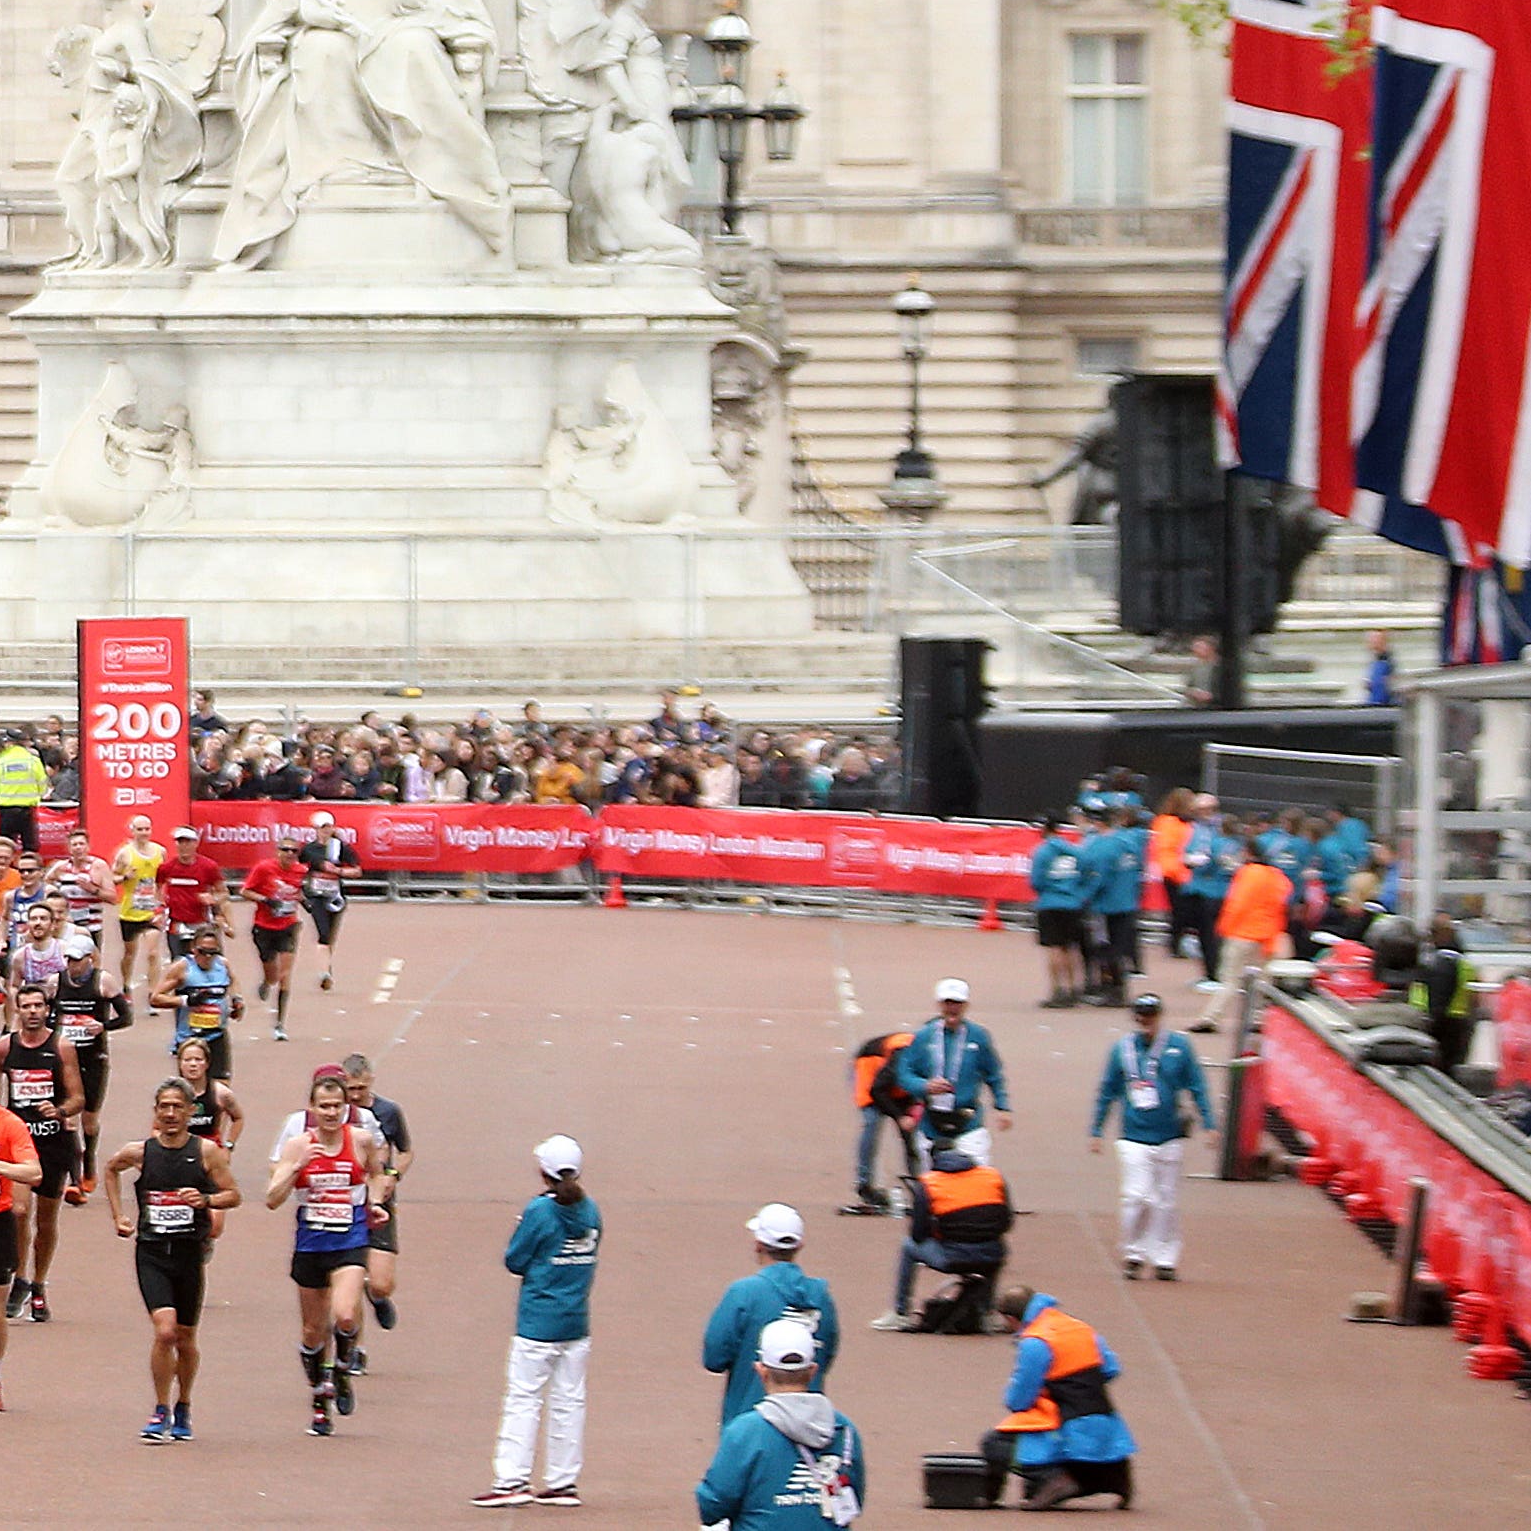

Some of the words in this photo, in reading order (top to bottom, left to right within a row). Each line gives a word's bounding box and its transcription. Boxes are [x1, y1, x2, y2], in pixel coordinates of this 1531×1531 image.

[92, 702, 182, 740] 200
[97, 742, 177, 761] METRES
[106, 761, 134, 779] TO
[137, 761, 170, 779] GO
[207, 822, 270, 843] London
[445, 823, 496, 852] Virgin
